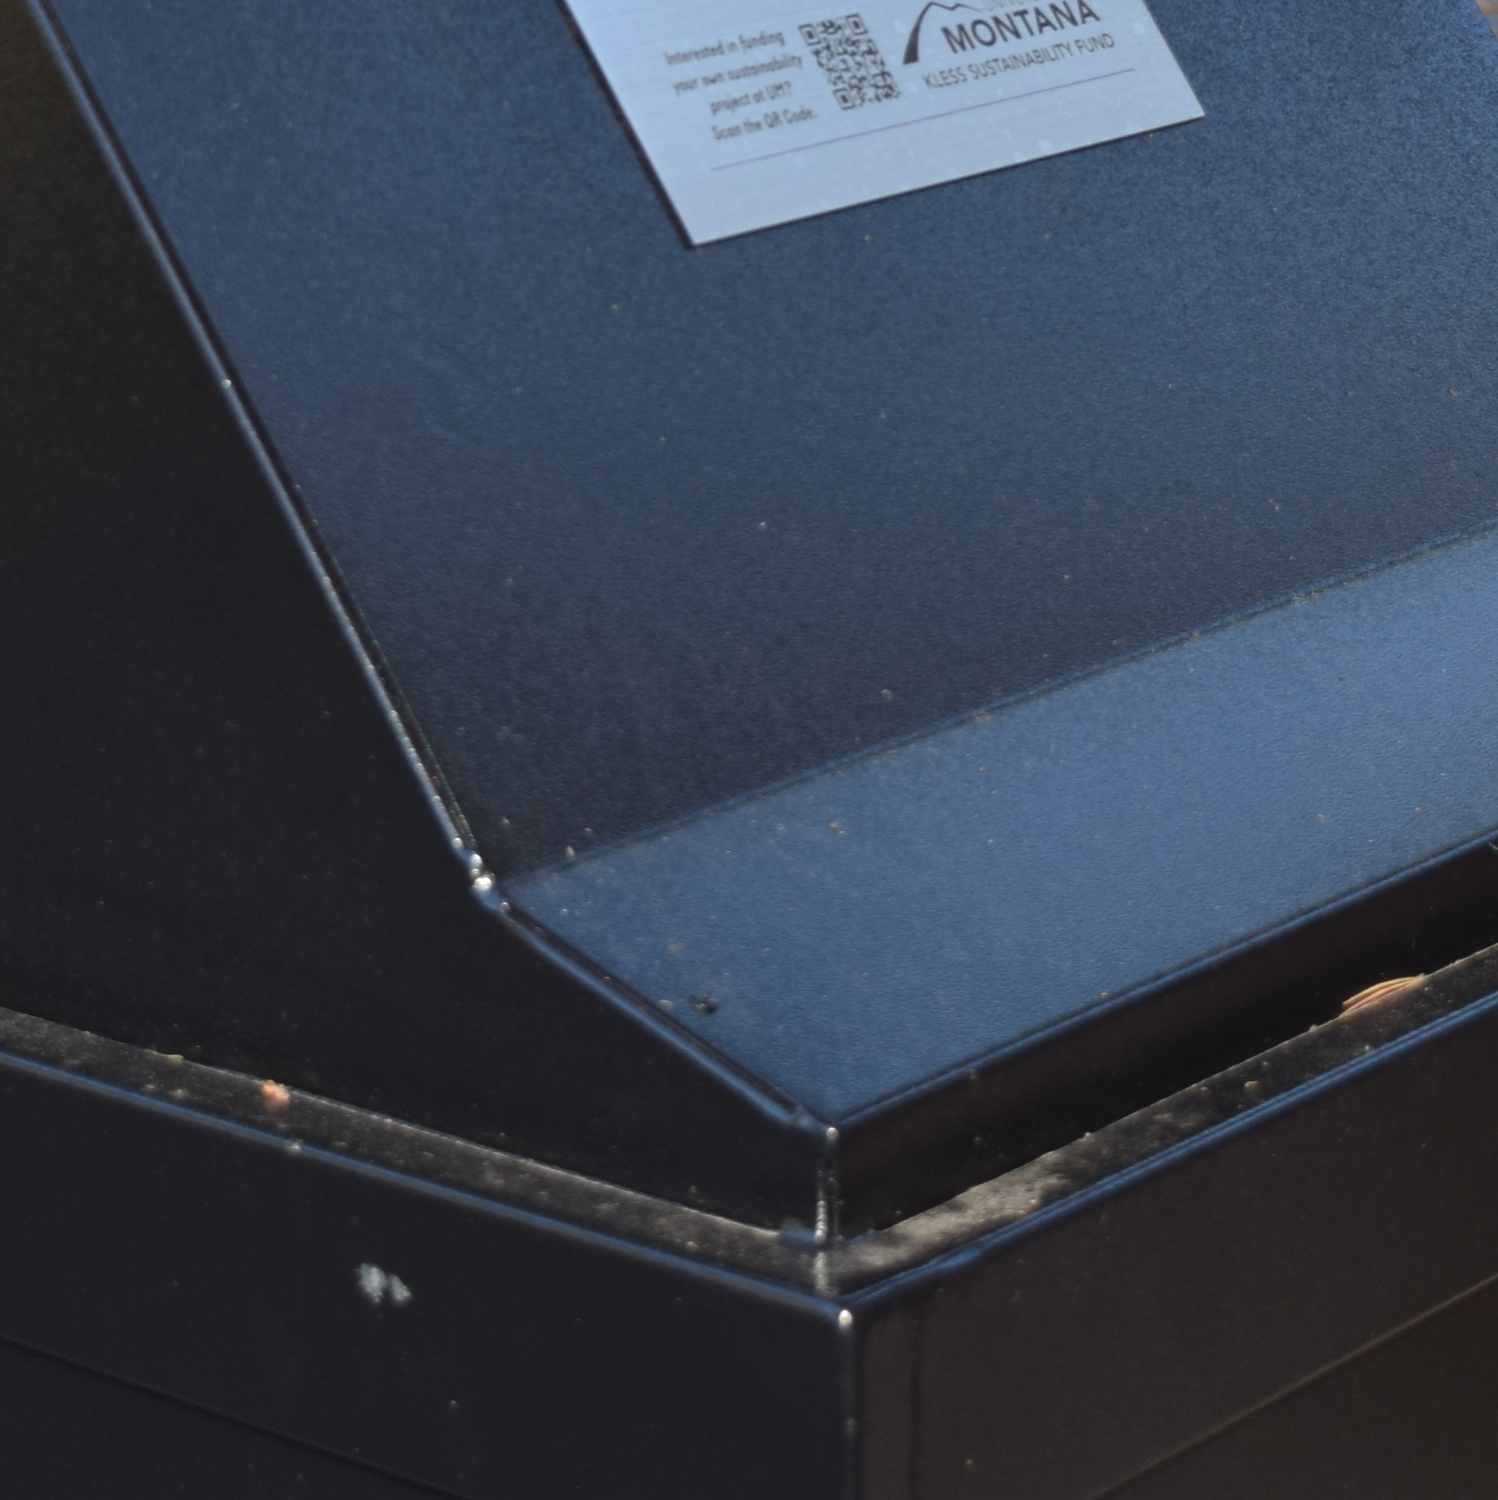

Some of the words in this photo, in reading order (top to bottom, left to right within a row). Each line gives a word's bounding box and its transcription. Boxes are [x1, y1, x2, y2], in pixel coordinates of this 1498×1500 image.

[664, 39, 724, 66] Interested
[726, 40, 738, 53] in
[738, 30, 785, 54] funding
[922, 66, 967, 89] KLESS
[967, 42, 1073, 80] SUSTAINABILITY
[1074, 33, 1115, 54] FUND
[673, 77, 698, 96] your
[702, 73, 724, 86] own
[727, 53, 802, 80] sustainability
[710, 93, 750, 116] project
[753, 90, 765, 103] at
[711, 124, 742, 140] Scan
[743, 117, 763, 132] the
[763, 111, 781, 128] QR
